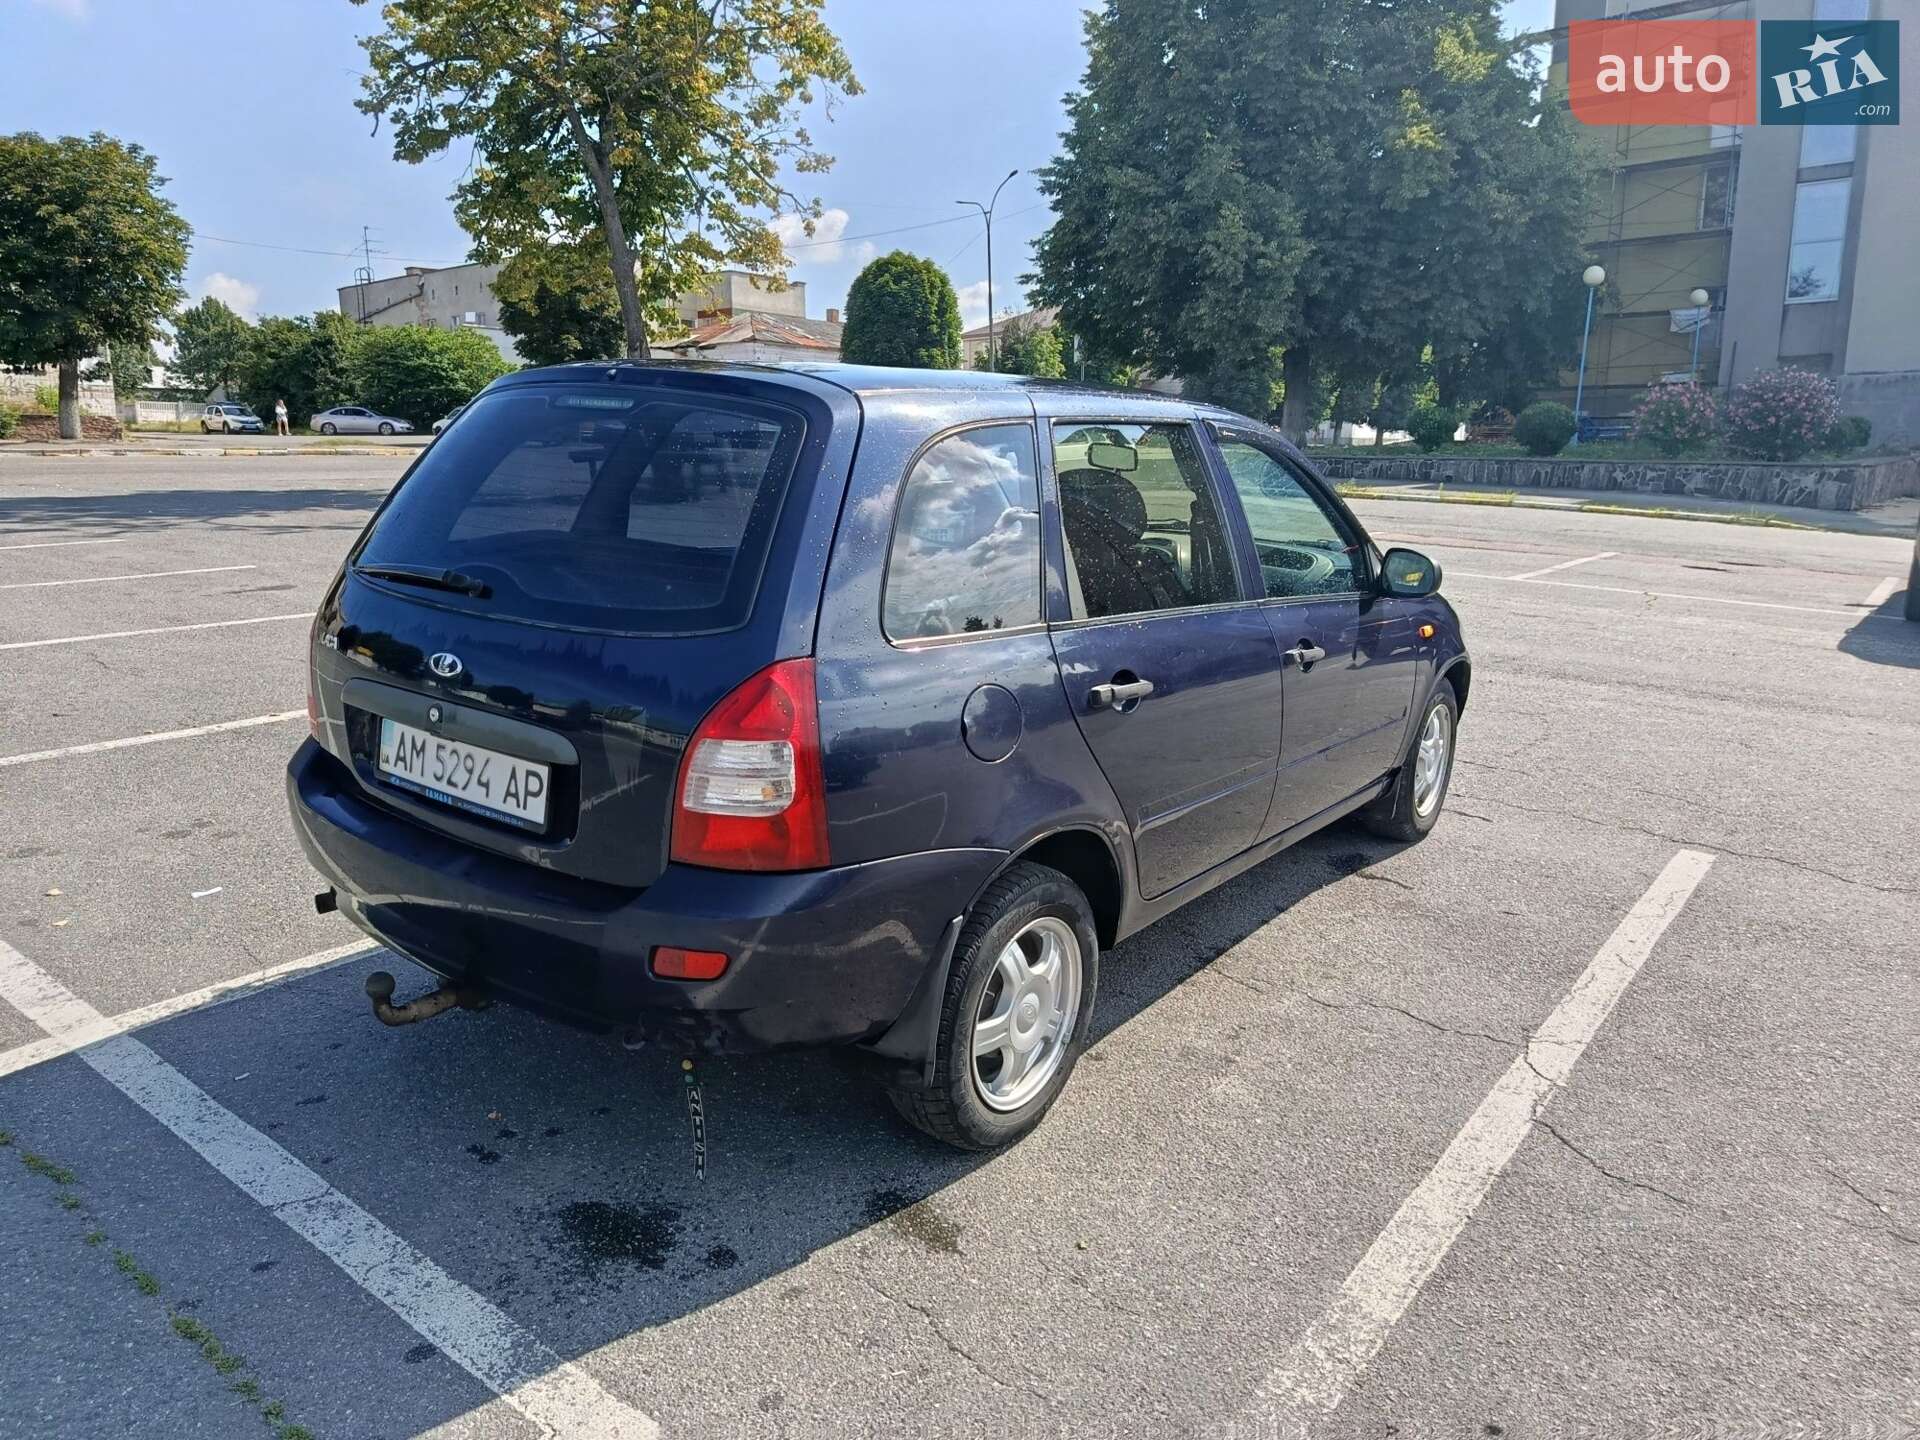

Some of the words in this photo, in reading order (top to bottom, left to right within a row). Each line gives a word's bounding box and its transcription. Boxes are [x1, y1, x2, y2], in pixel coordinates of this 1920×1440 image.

[394, 731, 427, 777] AM
[433, 744, 491, 798] 5294
[502, 764, 544, 811] AP
